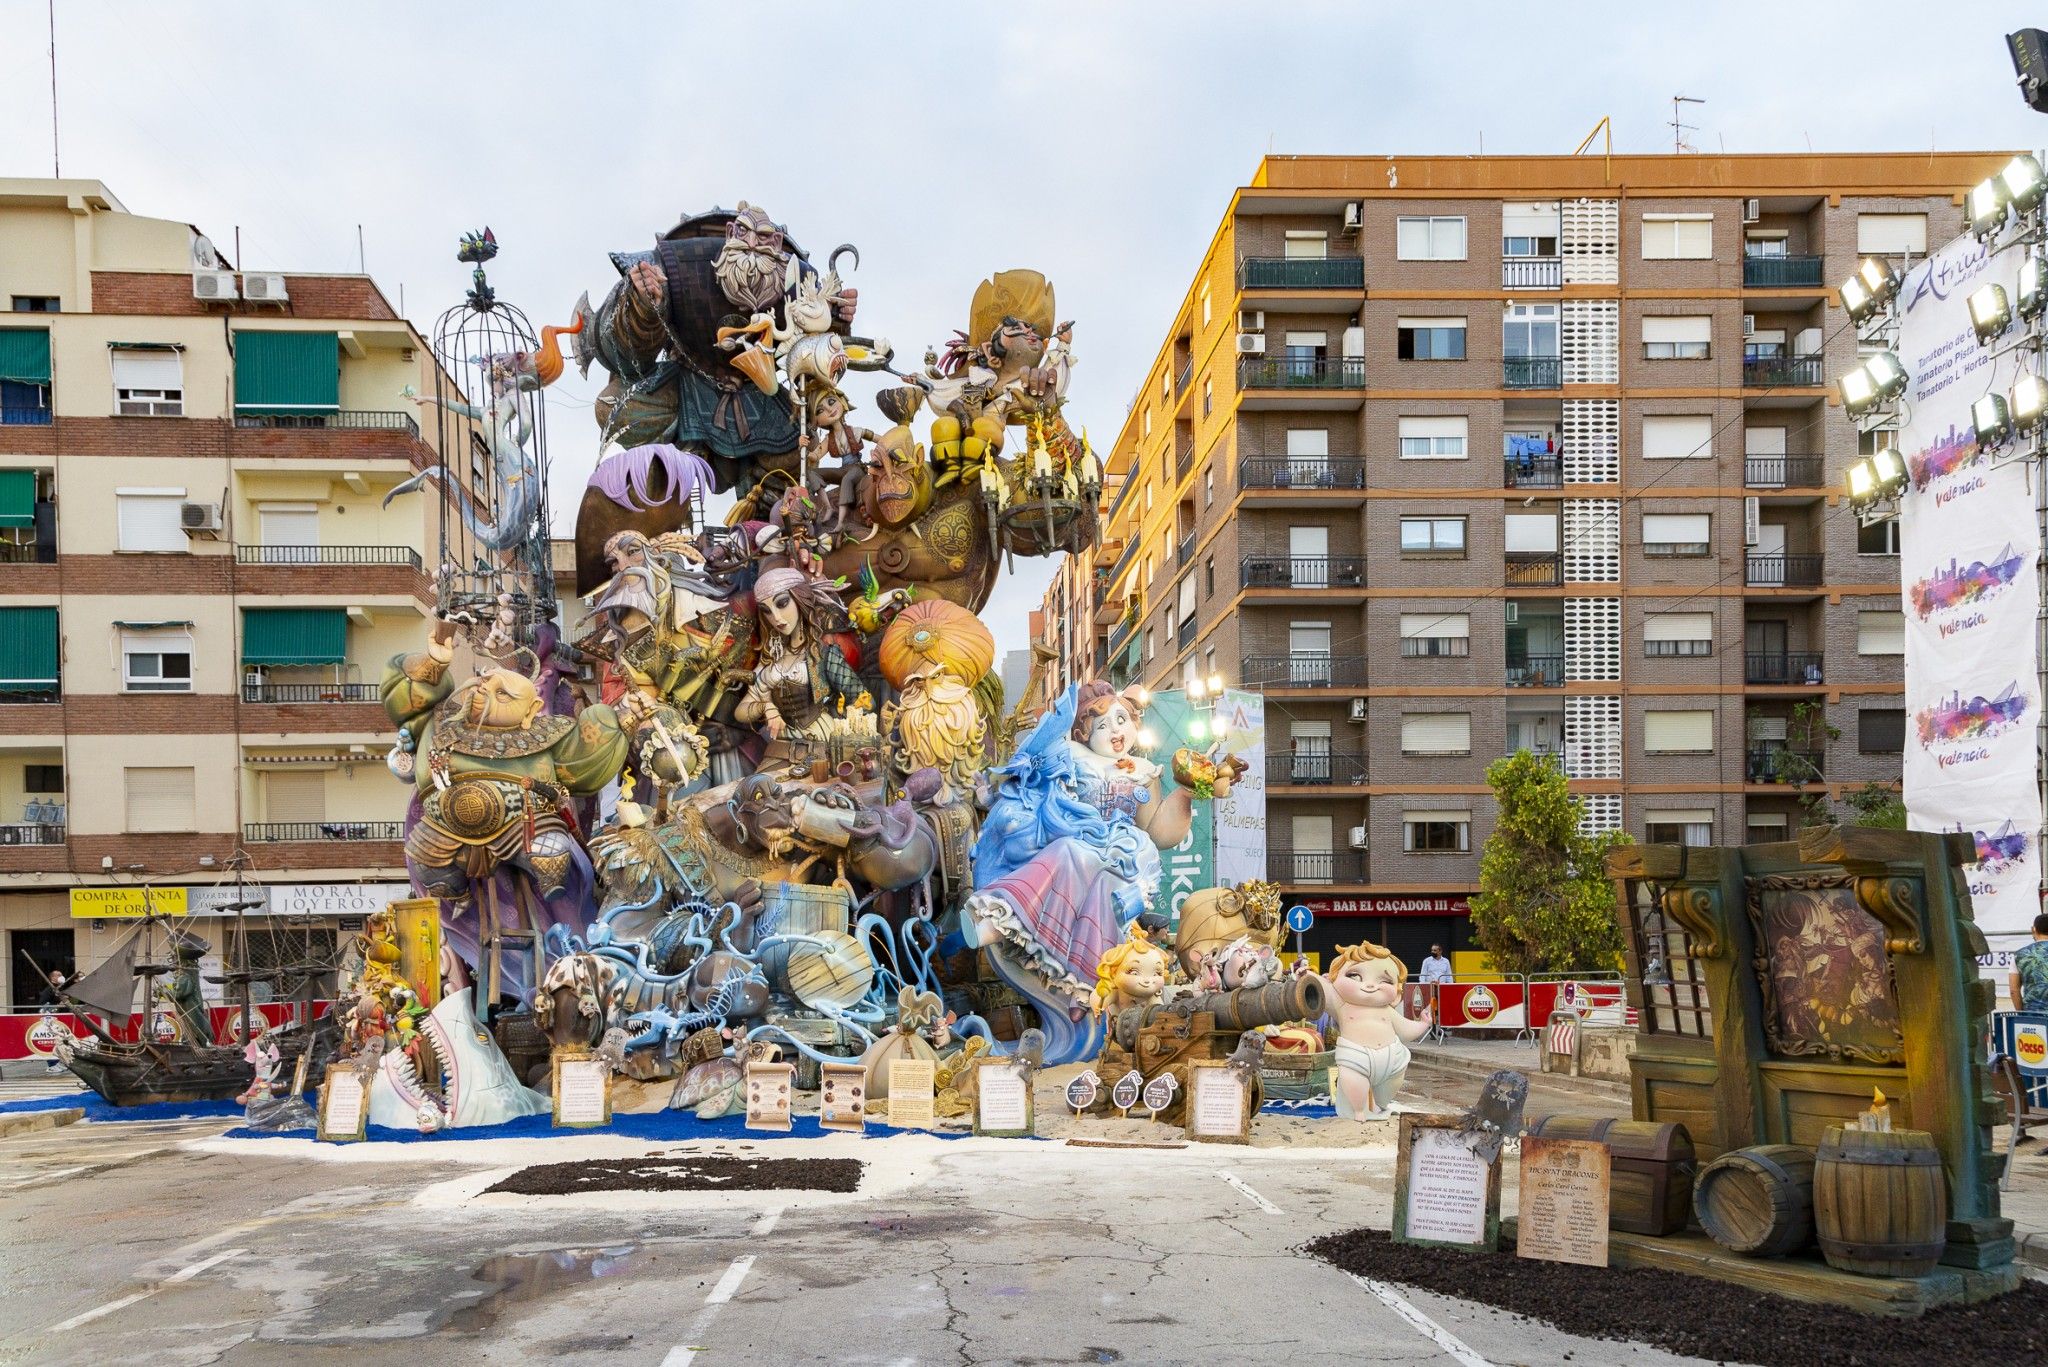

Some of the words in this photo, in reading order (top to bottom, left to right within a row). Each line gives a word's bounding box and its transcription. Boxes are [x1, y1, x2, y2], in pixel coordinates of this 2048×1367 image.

[1918, 341, 1954, 370] Tanatorio
[1954, 334, 1965, 346] de
[1916, 358, 1952, 386] Tanatorio
[1954, 343, 1974, 364] Pista
[1916, 376, 1954, 402] Tanatorio
[1936, 476, 1986, 508] Valencia
[1939, 612, 1988, 640] Valencia
[1938, 746, 1990, 769] Valencia
[1220, 800, 1236, 814] LAS
[1224, 814, 1266, 830] PALMERAS
[74, 891, 128, 902] COMPRA
[141, 890, 182, 900] VENTA
[294, 886, 366, 898] MORAL
[105, 904, 120, 914] DE
[284, 897, 376, 912] JOYEROS
[1333, 900, 1357, 912] BAR
[1360, 900, 1374, 911] EL
[1376, 900, 1432, 914] CAÇADOR
[1434, 900, 1448, 911] III
[2018, 1038, 2044, 1054] Dacsa
